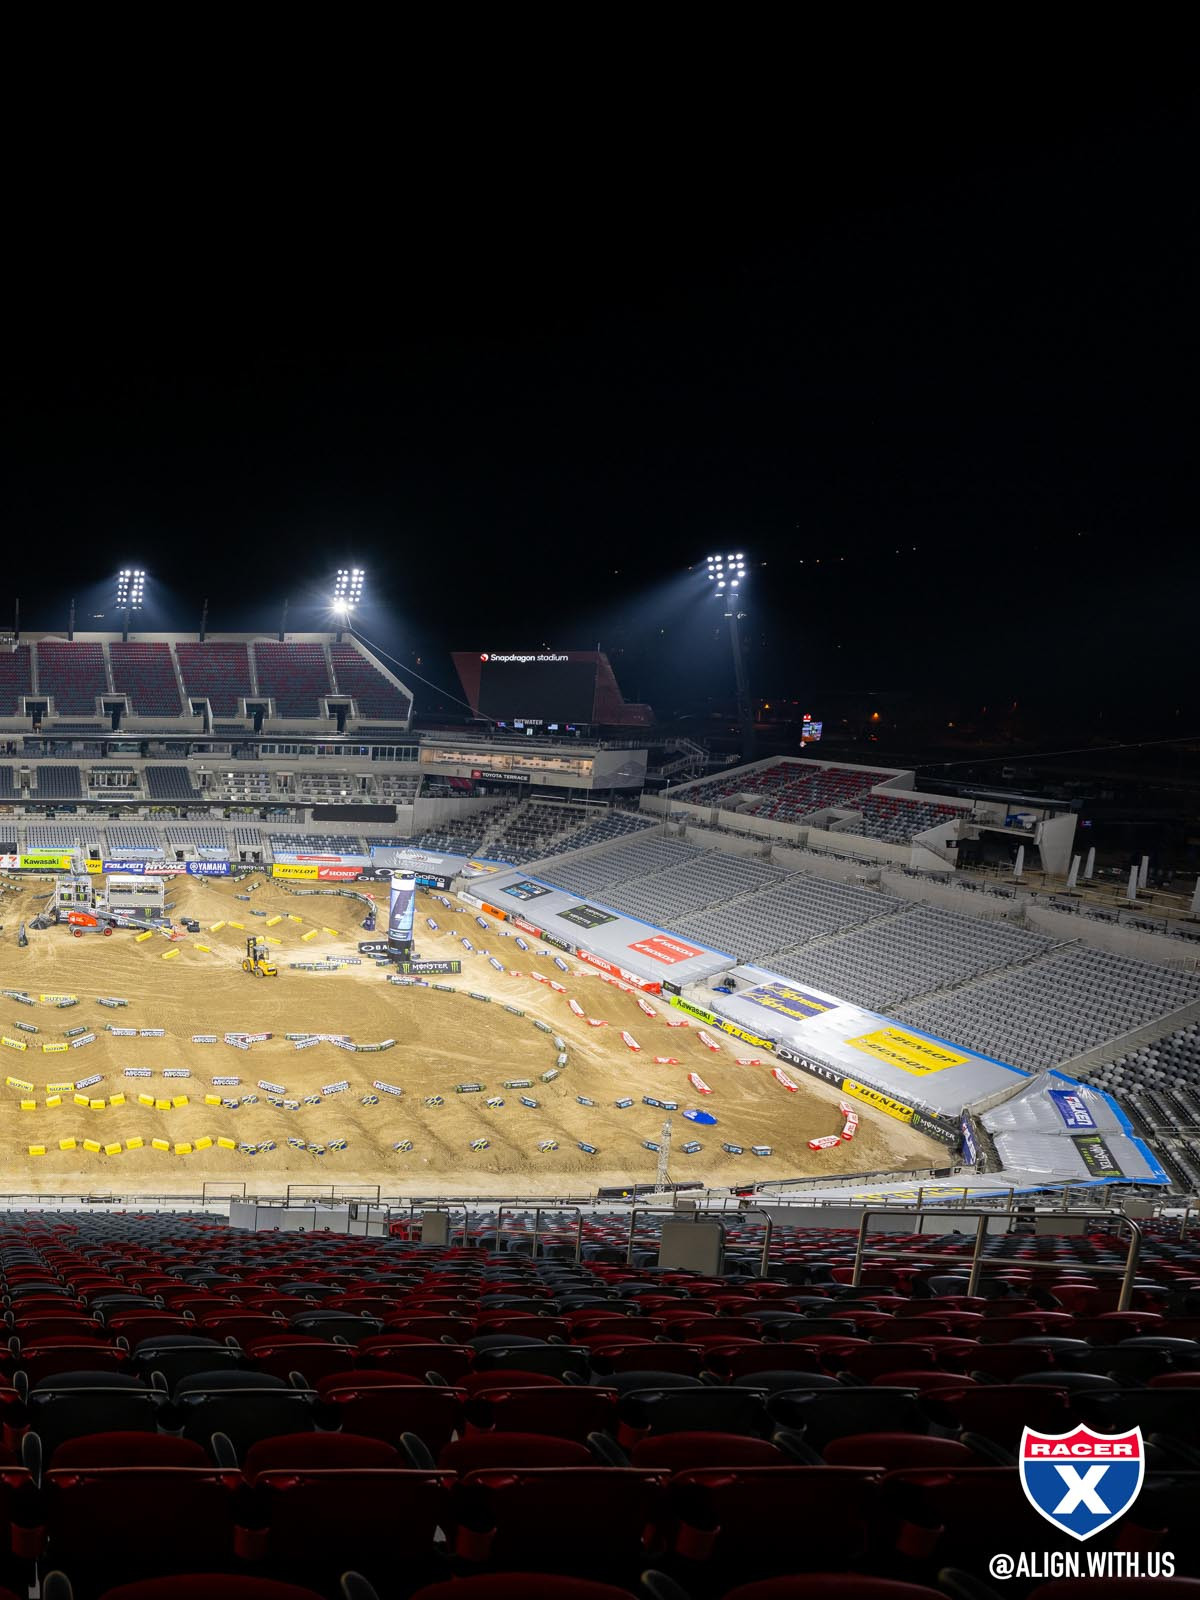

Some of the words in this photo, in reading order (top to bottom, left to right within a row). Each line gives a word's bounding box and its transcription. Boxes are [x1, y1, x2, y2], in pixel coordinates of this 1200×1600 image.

[490, 653, 536, 663] Snapdragon
[536, 654, 569, 662] stadium
[198, 863, 227, 871] YAMAHA
[414, 872, 446, 883] GoPro
[644, 946, 676, 963] HONDA
[661, 940, 695, 957] HONDA
[587, 955, 612, 971] HONDA
[676, 998, 711, 1024] Kawasaki
[866, 1043, 933, 1071] DUNLOP
[892, 1035, 959, 1063] DUNLOP
[792, 1054, 842, 1083] OAKLEY
[859, 1088, 912, 1115] DUNLO
[1063, 1095, 1094, 1127] FALKEN
[920, 1118, 956, 1141] MONSTER
